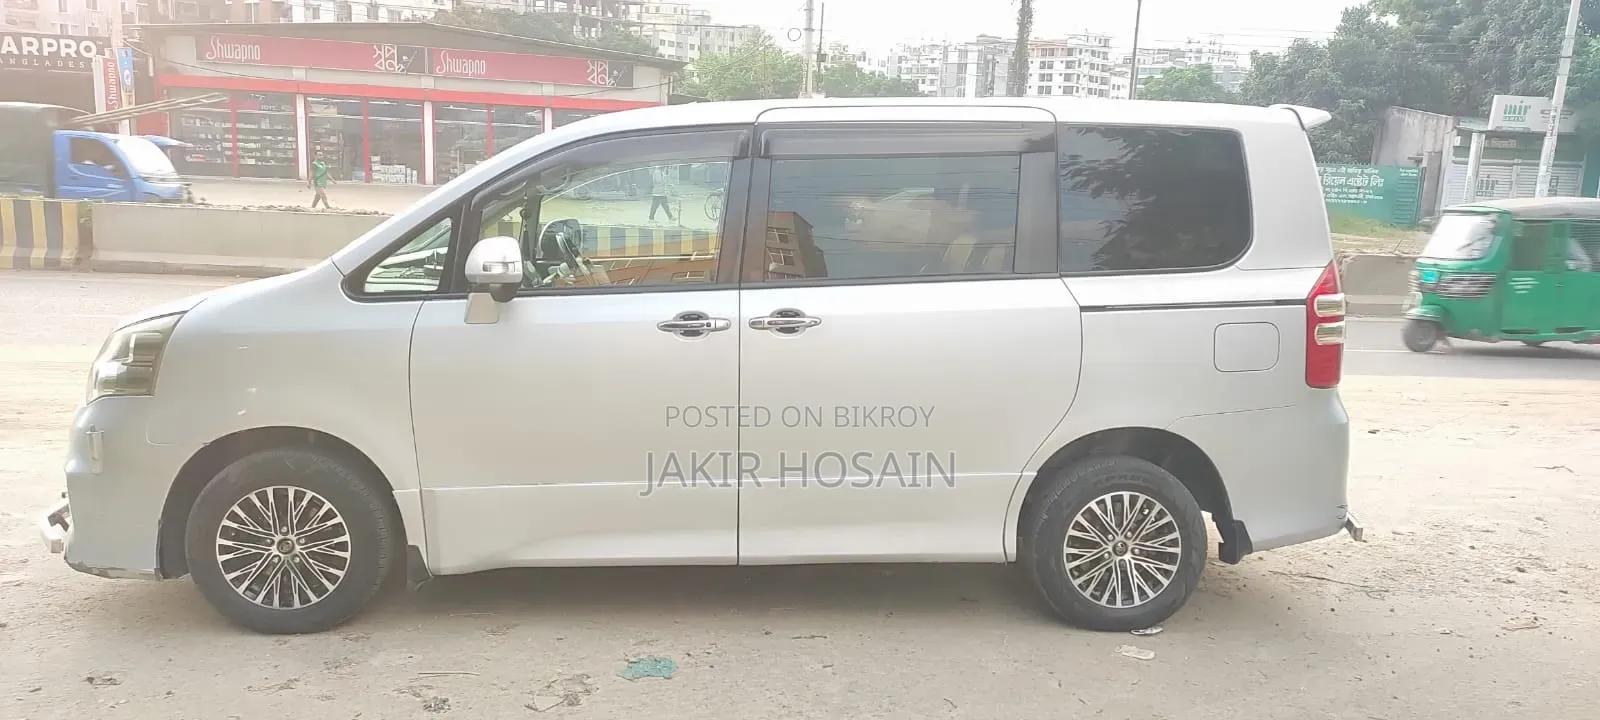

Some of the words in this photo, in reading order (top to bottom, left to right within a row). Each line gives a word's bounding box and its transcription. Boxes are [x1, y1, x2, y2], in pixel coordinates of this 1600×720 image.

[206, 36, 261, 62] Shwapno
[0, 57, 93, 68] ANGLADES
[436, 50, 486, 76] Shwapno
[107, 62, 118, 109] Shwapno
